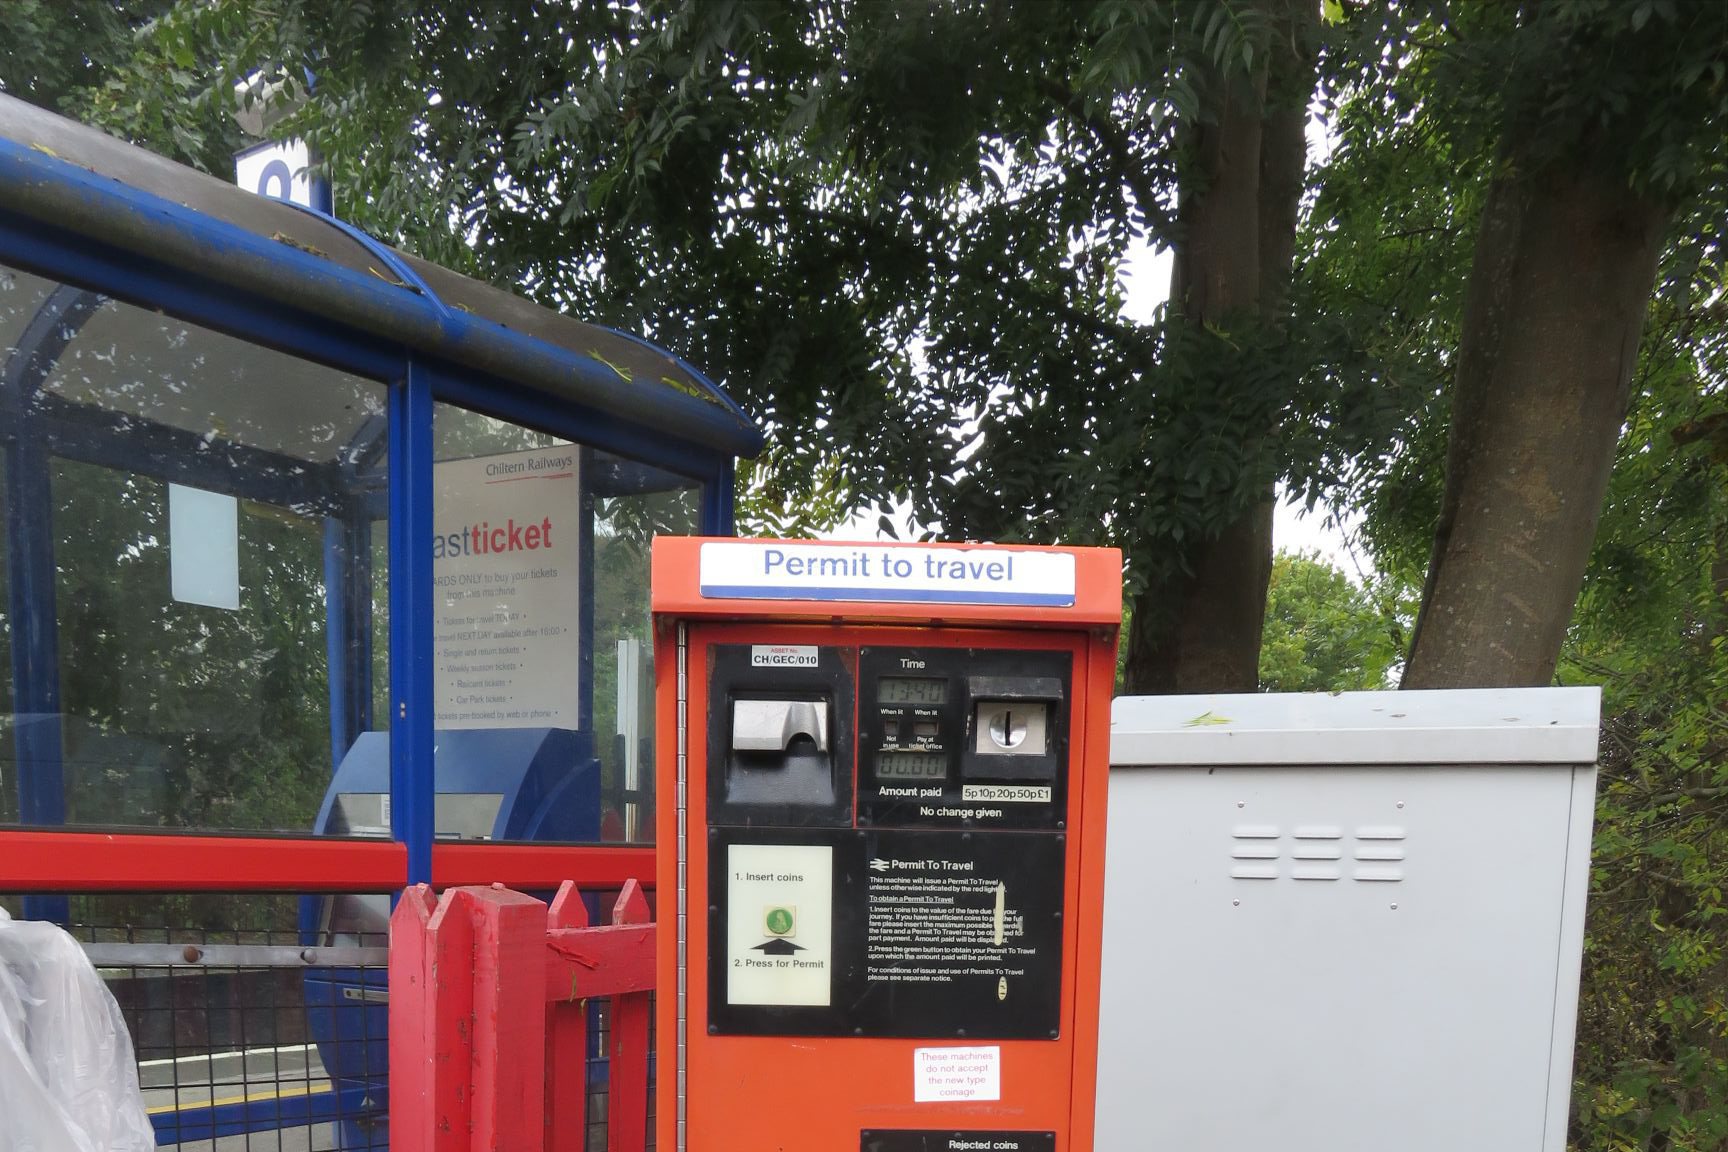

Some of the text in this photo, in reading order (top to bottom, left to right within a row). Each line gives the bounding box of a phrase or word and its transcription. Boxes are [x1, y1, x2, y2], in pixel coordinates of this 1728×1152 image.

[486, 455, 573, 476] Chiltern Railways
[433, 516, 552, 559] astticket
[764, 550, 1014, 581] Permit to travel
[458, 567, 558, 584] ONLY to buy your tickets
[754, 655, 817, 664] CH/GEC/010
[900, 658, 925, 668] Time
[879, 785, 942, 798] Amount paid
[965, 788, 1049, 799] 5p 10p 20p 50p £1
[920, 806, 1002, 819] No change given
[892, 860, 974, 870] Permit To Travel
[735, 872, 804, 882] 1. Insert coins
[947, 877, 968, 885] Permit
[978, 878, 999, 886] Travel
[977, 954, 1002, 962] printed.
[734, 959, 824, 968] 2. Press for Permit
[1004, 968, 1024, 976] Travel
[921, 1052, 993, 1061] These machines
[926, 1064, 988, 1074] do not accept
[967, 1077, 986, 1086] type
[940, 1089, 975, 1097] coinage
[949, 1140, 1019, 1151] Rejected coins
